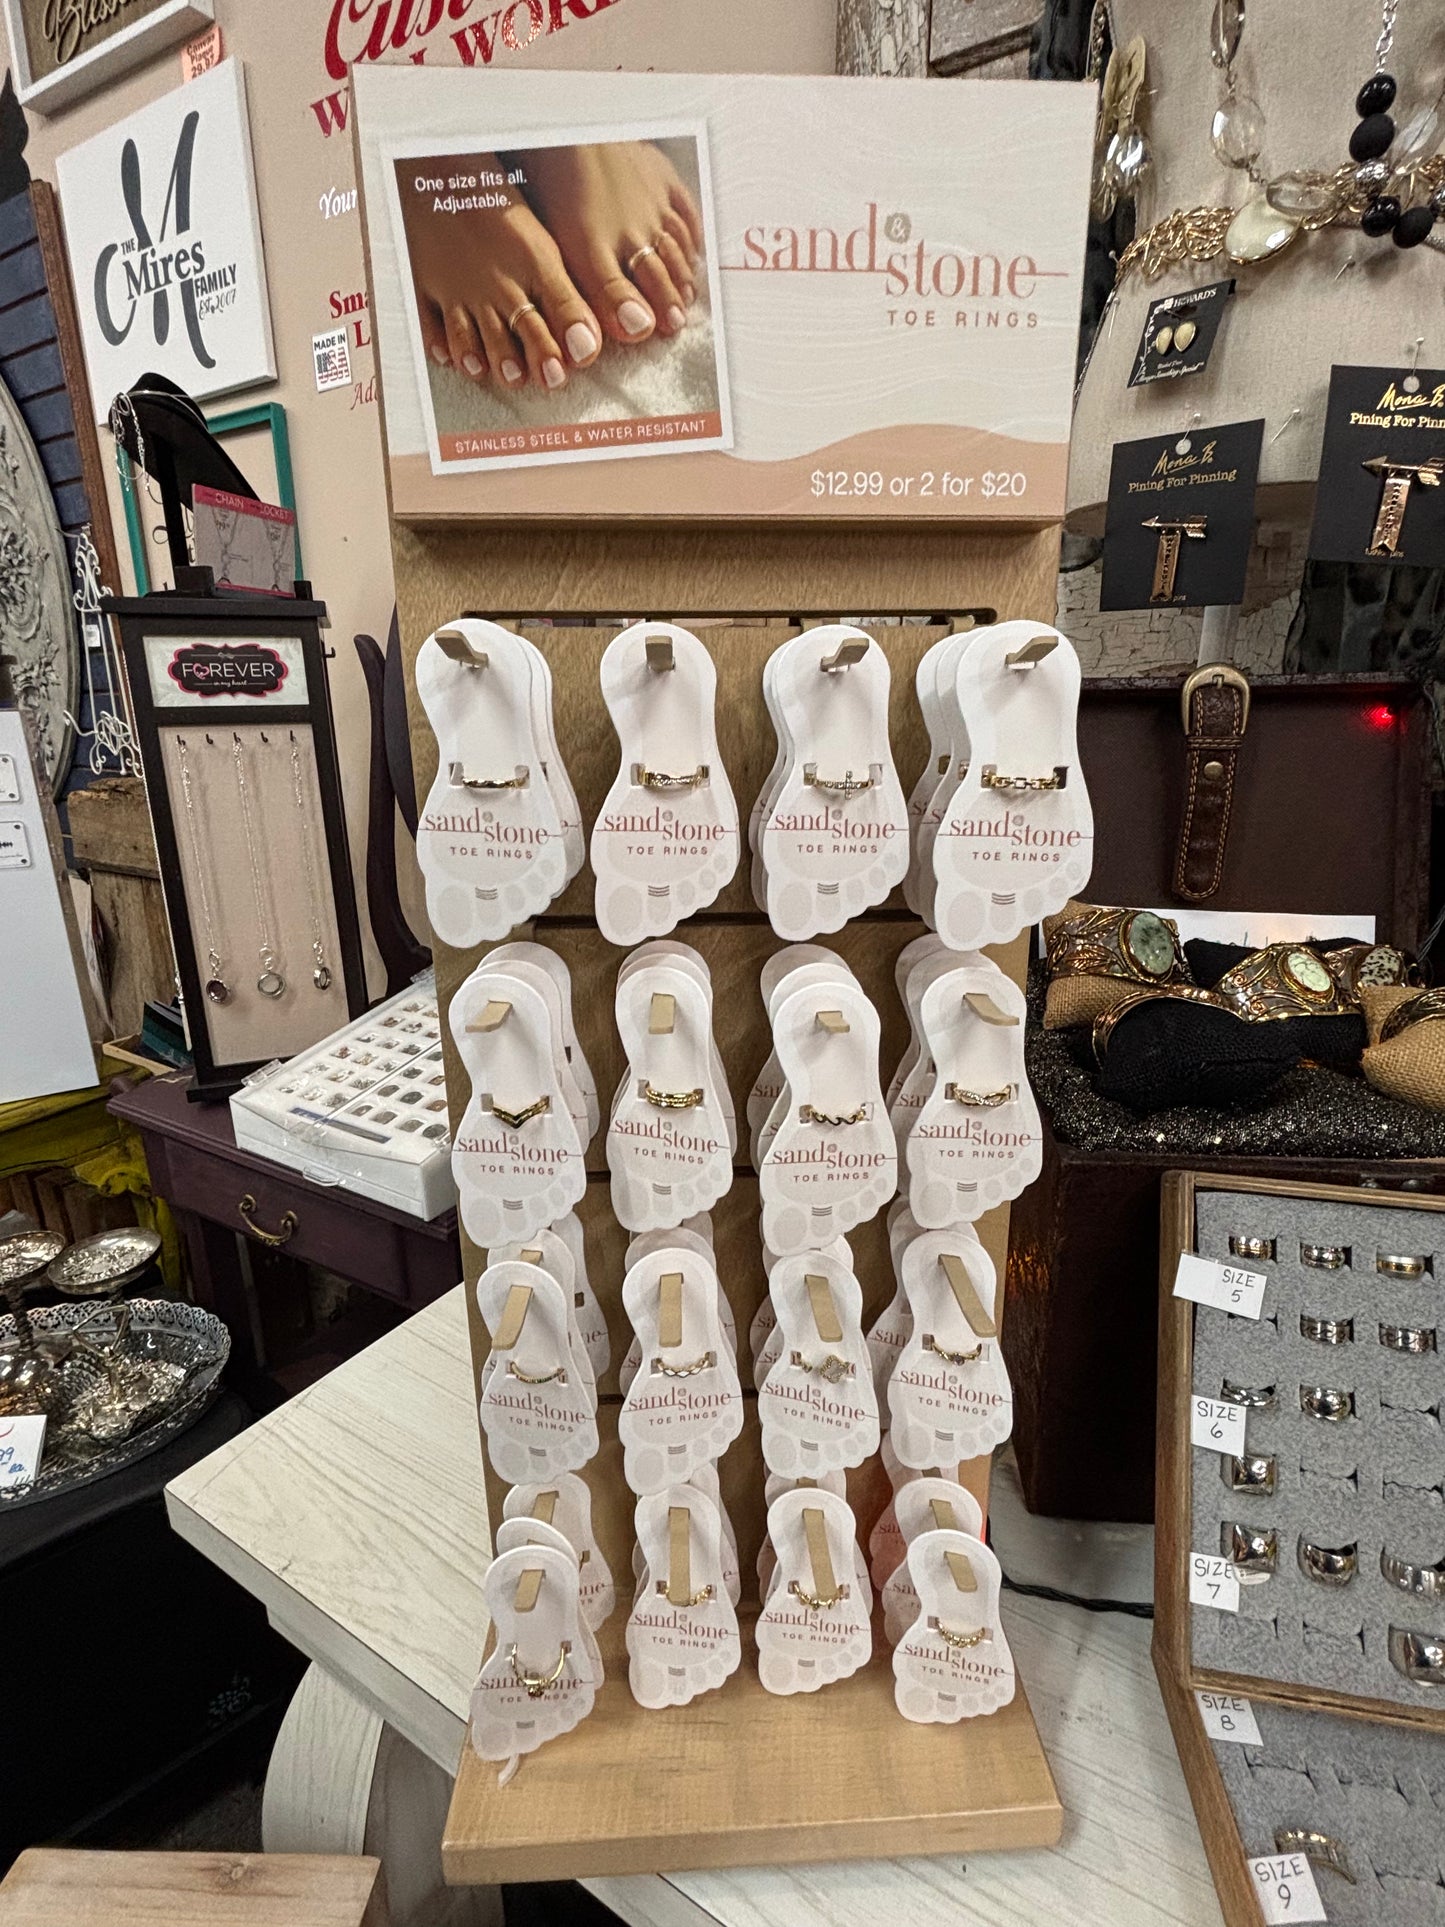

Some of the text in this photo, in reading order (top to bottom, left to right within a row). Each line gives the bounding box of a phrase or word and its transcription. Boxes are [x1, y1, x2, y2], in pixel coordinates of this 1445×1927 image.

[415, 169, 527, 192] One size fits all.
[433, 192, 512, 214] Adjustable.
[121, 238, 136, 256] THE
[743, 202, 877, 272] sand
[885, 238, 1038, 299] stone
[122, 241, 205, 300] Mires
[194, 264, 237, 298] FAMILY
[214, 289, 237, 313] 2007
[887, 309, 1039, 329] TOE RINGS
[314, 333, 346, 350] MADE IN
[1376, 382, 1428, 411] Mona
[1350, 412, 1445, 428] Pining For Pinn
[455, 419, 707, 454] STAINLESS STEEL & WATER RESISTANT
[1151, 449, 1198, 477] Mona
[810, 470, 1027, 498] $12.99 or 2 for $20
[1128, 469, 1238, 494] Pining For Pinning
[215, 492, 289, 520] CHAIN LOCKET
[182, 663, 276, 680] FOREVER
[425, 807, 481, 833] sand
[484, 820, 549, 845] stone
[604, 807, 726, 842] sand stone
[774, 807, 896, 840] sand stone
[950, 811, 1010, 838] sand
[1011, 823, 1081, 848] stone
[450, 846, 533, 860] TOE RINGS
[627, 846, 709, 856] TOE RINGS
[797, 844, 878, 854] TOE RINGS
[972, 852, 1061, 863] TOE RINGS
[614, 1117, 719, 1154] sand stone
[919, 1118, 1032, 1148] sand stone
[458, 1132, 569, 1164] sand stone
[634, 1147, 705, 1165] TOE RINGS
[772, 1141, 886, 1170] sand stone
[939, 1150, 1015, 1160] TOE RINGS
[480, 1165, 555, 1176] TOE RINGS
[793, 1172, 870, 1183] TOE RINGS
[1222, 1268, 1256, 1288] SIZE
[1230, 1289, 1243, 1303] 5
[628, 1387, 731, 1412] sand stone
[900, 1369, 1004, 1409] sand stone
[489, 1391, 586, 1425] sand stone
[765, 1381, 865, 1422] sand stone
[918, 1397, 989, 1417] TOE RINGS
[1197, 1402, 1238, 1422] SIZE
[509, 1416, 575, 1433] TOE RINGS
[649, 1411, 718, 1427] TOE RINGS
[783, 1407, 851, 1430] TOE RINGS
[1210, 1422, 1224, 1439] 6
[1194, 1558, 1234, 1578] SIZE
[1206, 1583, 1221, 1600] 7
[634, 1611, 729, 1640] sand stone
[764, 1609, 860, 1636] sand stone
[651, 1636, 716, 1650] TOE RINGS
[782, 1632, 847, 1645] TOE RINGS
[904, 1643, 1005, 1679] sand stone
[922, 1665, 990, 1685] TOE RINGS
[1201, 1694, 1245, 1712] SIZE
[1220, 1714, 1236, 1732] 8
[1254, 1856, 1305, 1883] SIZE
[1277, 1883, 1292, 1910] 9
